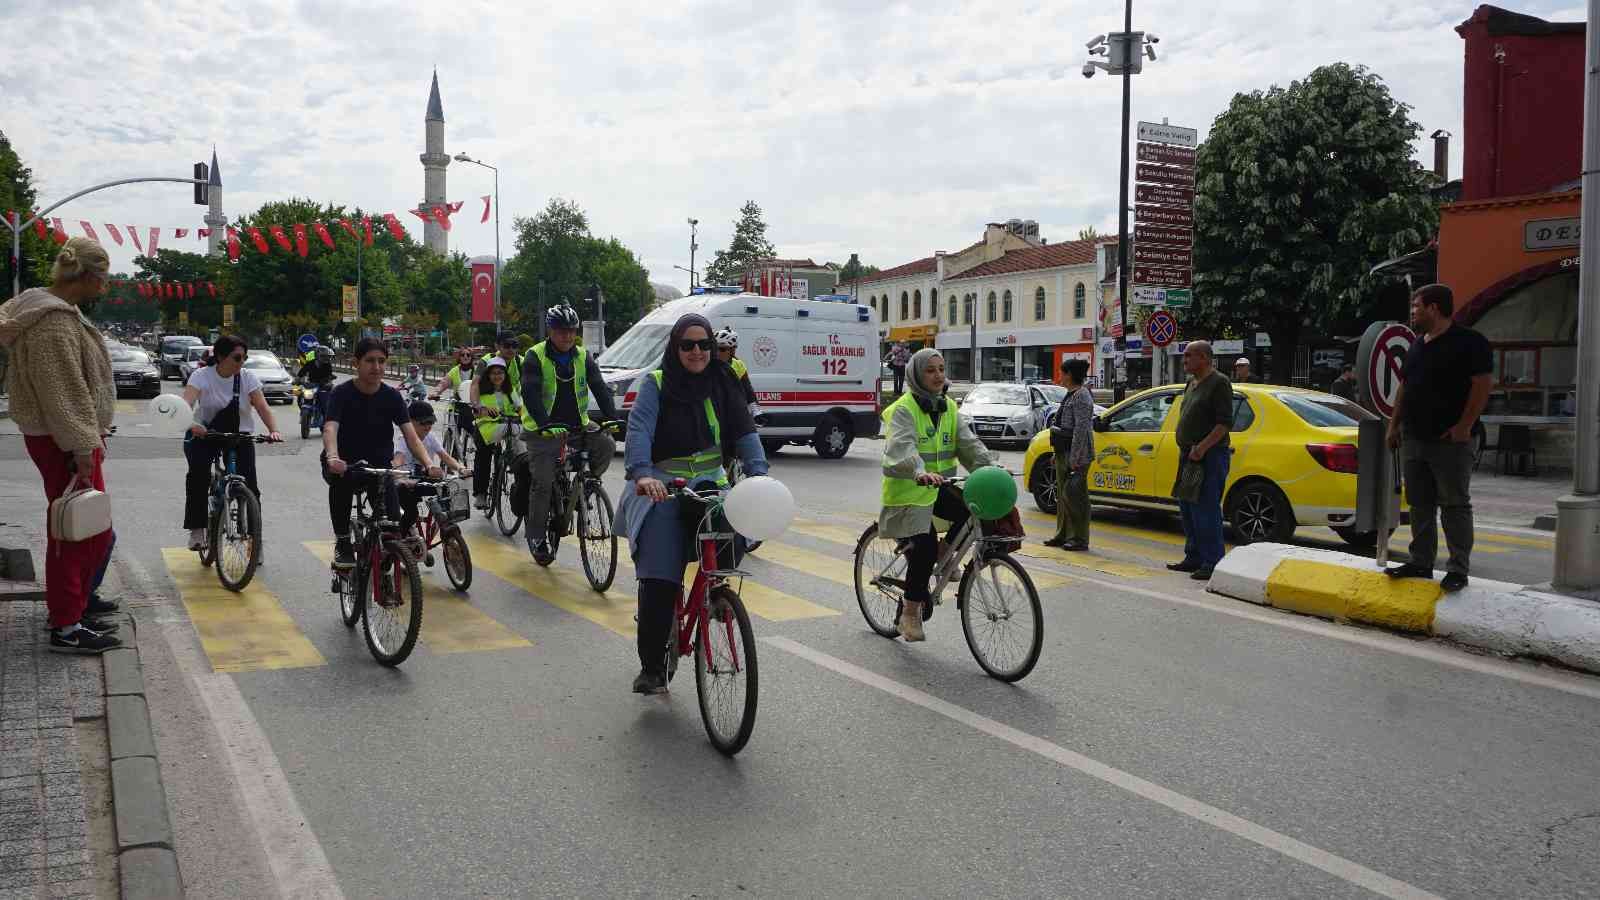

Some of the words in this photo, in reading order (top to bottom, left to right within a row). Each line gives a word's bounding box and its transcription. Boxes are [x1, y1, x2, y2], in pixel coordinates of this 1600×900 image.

[996, 335, 1009, 345] ING
[802, 344, 827, 356] SAĞLIK
[831, 345, 865, 358] BAKANLIĞI
[822, 359, 848, 376] 112
[755, 392, 782, 401] ULANS
